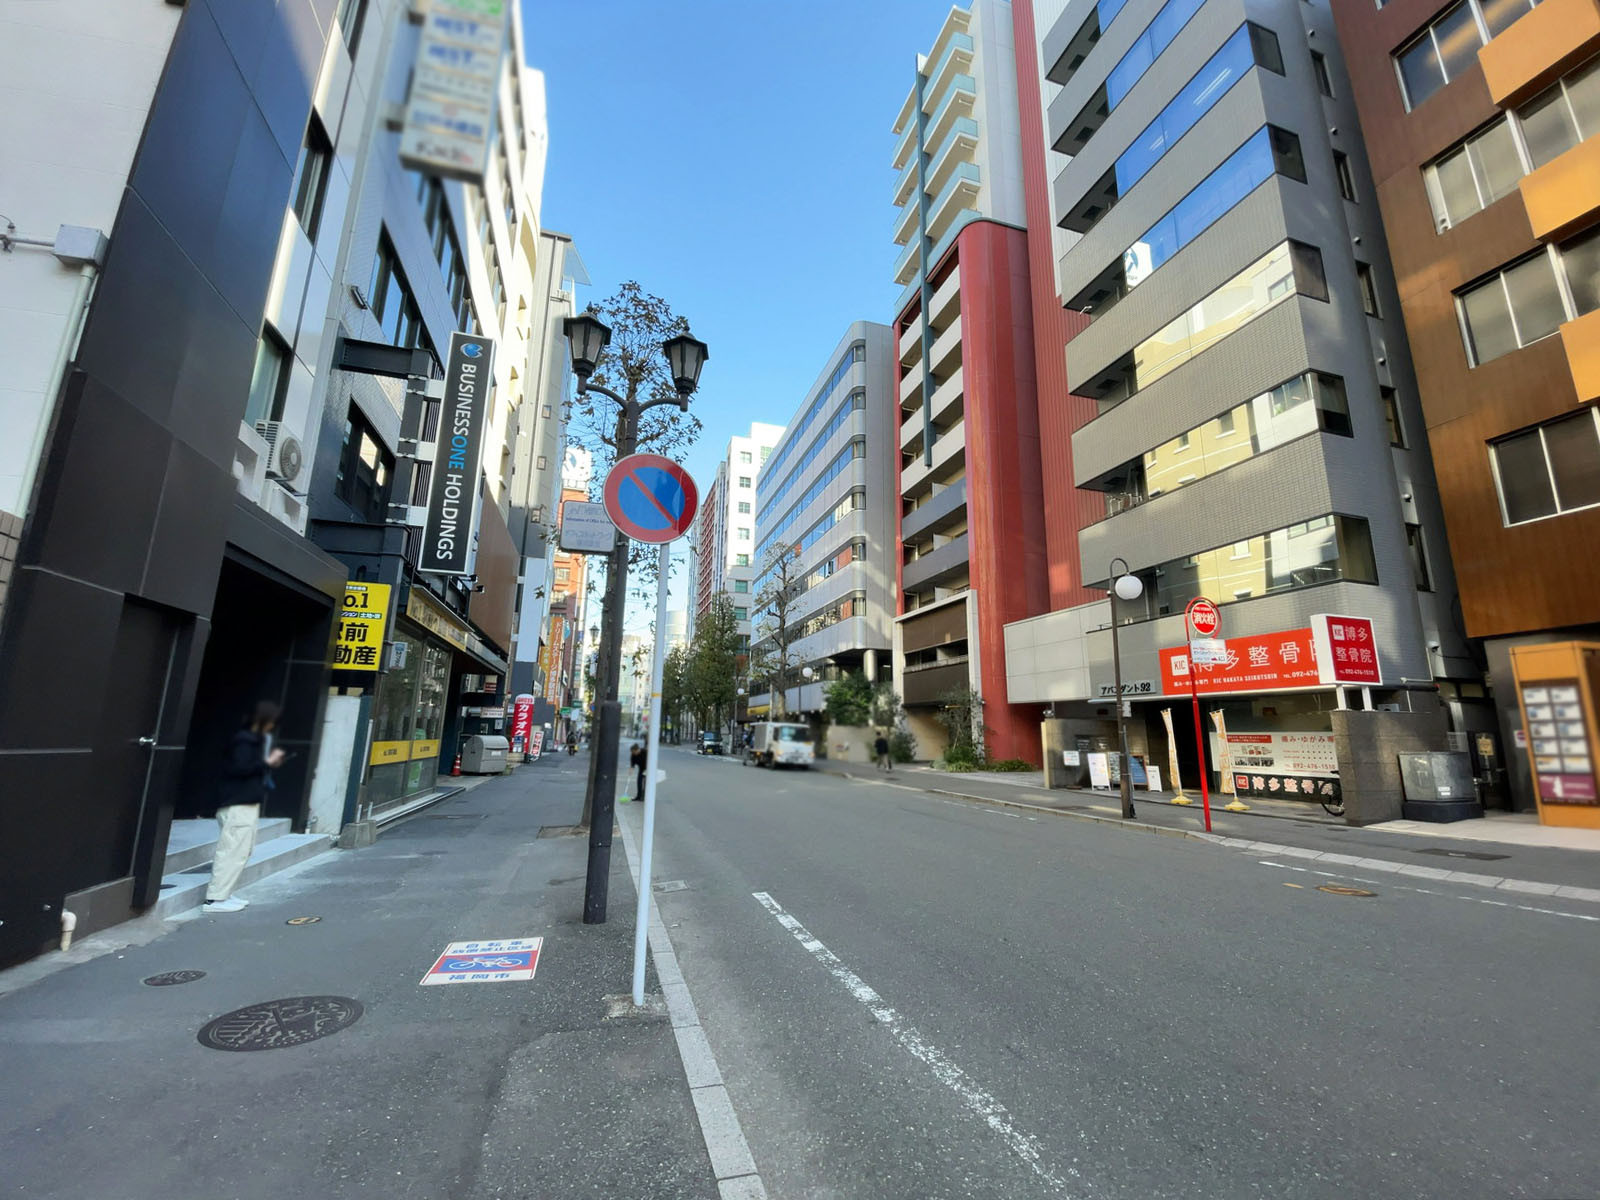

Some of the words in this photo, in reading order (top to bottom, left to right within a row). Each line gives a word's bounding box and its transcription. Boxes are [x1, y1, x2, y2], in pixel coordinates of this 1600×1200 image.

[436, 473, 463, 561] HOLDINGS
[1193, 612, 1215, 625] 消火栓
[1345, 626, 1368, 642] 博多
[1335, 646, 1372, 663] 整骨院
[1174, 659, 1186, 670] KIC
[515, 704, 530, 736] カラオケ
